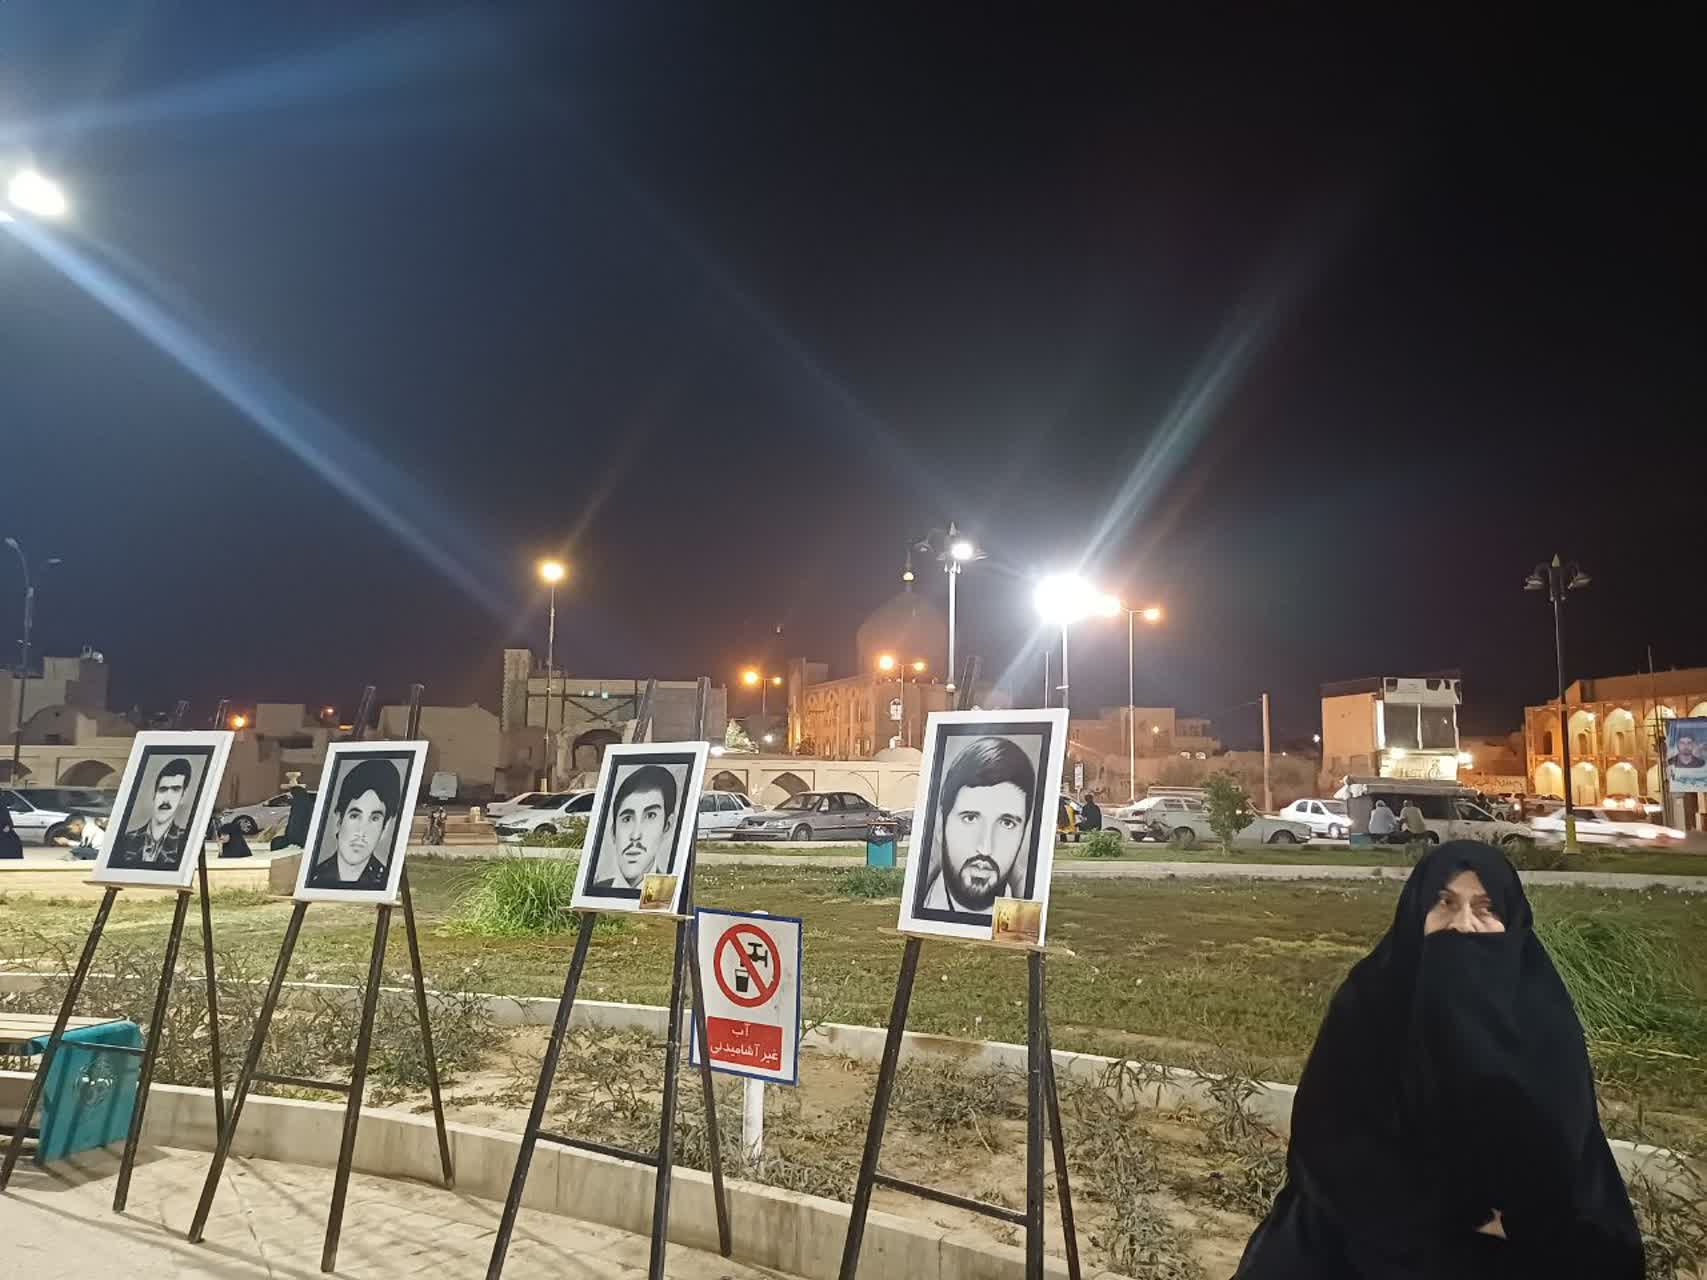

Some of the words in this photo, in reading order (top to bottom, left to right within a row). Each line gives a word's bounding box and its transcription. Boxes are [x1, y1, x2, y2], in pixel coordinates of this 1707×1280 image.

[731, 1023, 751, 1037] آب
[710, 1042, 760, 1057] آشامیدنی
[760, 1048, 779, 1063] غیر
